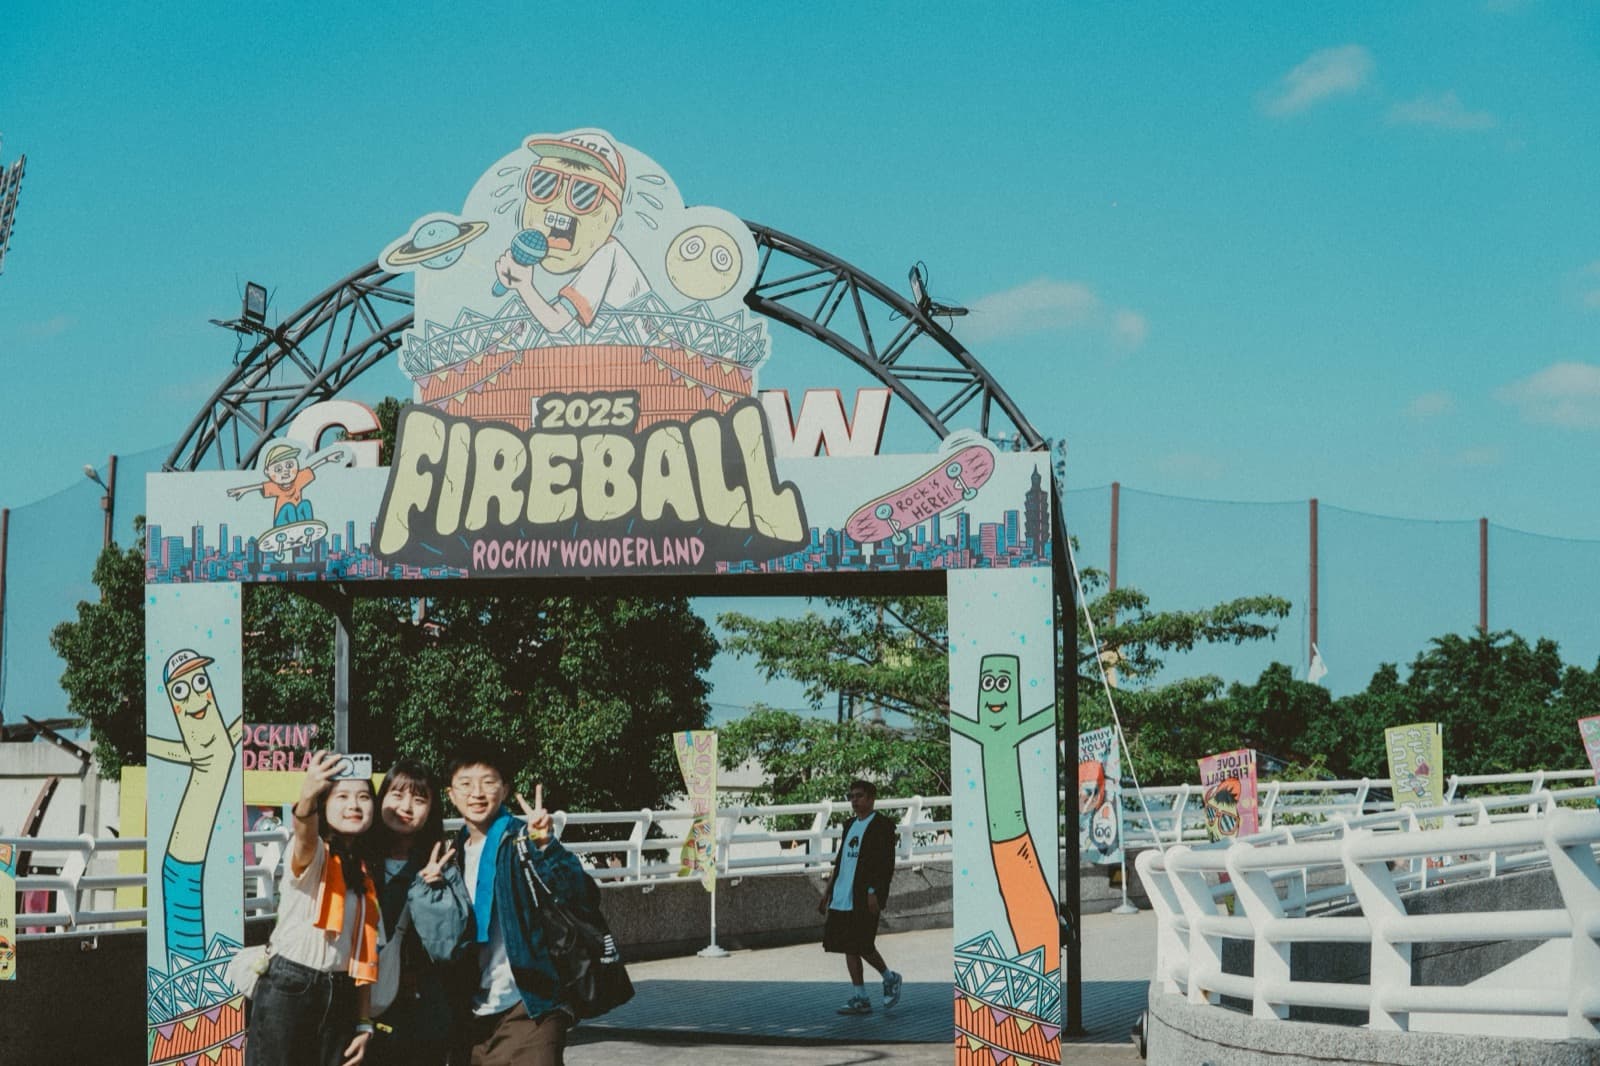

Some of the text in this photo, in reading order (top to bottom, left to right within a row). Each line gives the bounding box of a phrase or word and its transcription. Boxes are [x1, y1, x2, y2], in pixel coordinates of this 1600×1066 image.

[542, 397, 635, 429] 2025
[380, 404, 805, 556] FIREBALL
[895, 486, 929, 513] ROCK
[560, 536, 706, 568] WONDERLAND
[243, 724, 319, 748] OCKIN'
[243, 750, 314, 771] DERLA
